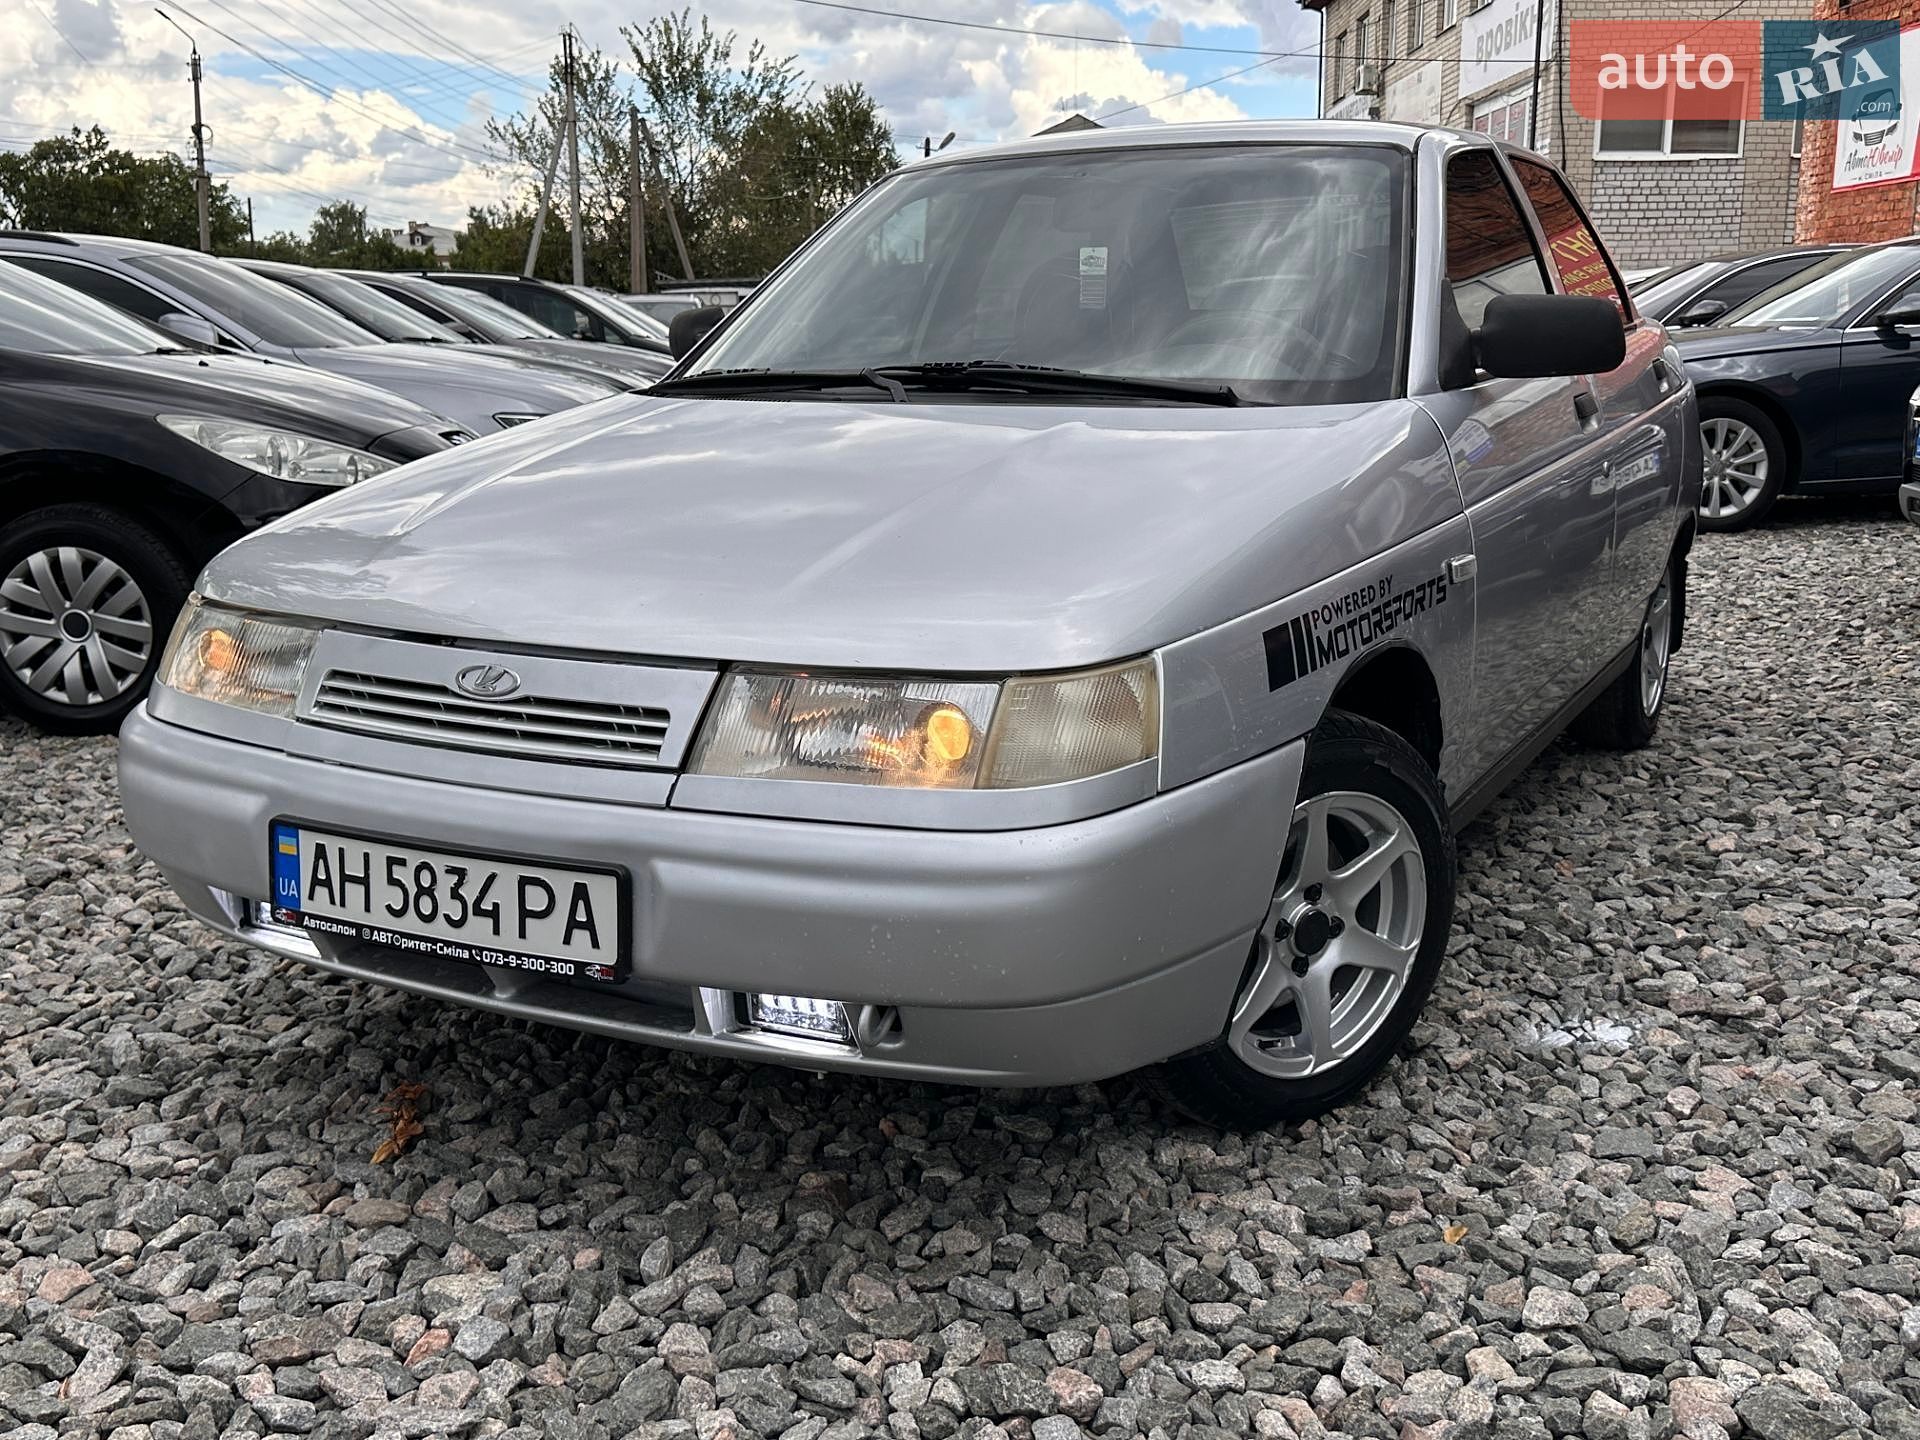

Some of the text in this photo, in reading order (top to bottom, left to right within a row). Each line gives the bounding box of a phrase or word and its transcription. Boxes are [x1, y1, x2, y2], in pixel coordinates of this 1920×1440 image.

[1310, 574, 1394, 630] POWERED BY
[1315, 574, 1448, 668] MOTORSPORTS
[278, 876, 299, 899] UA
[303, 915, 357, 938] Автосалон
[482, 950, 575, 976] 073-9-300-300
